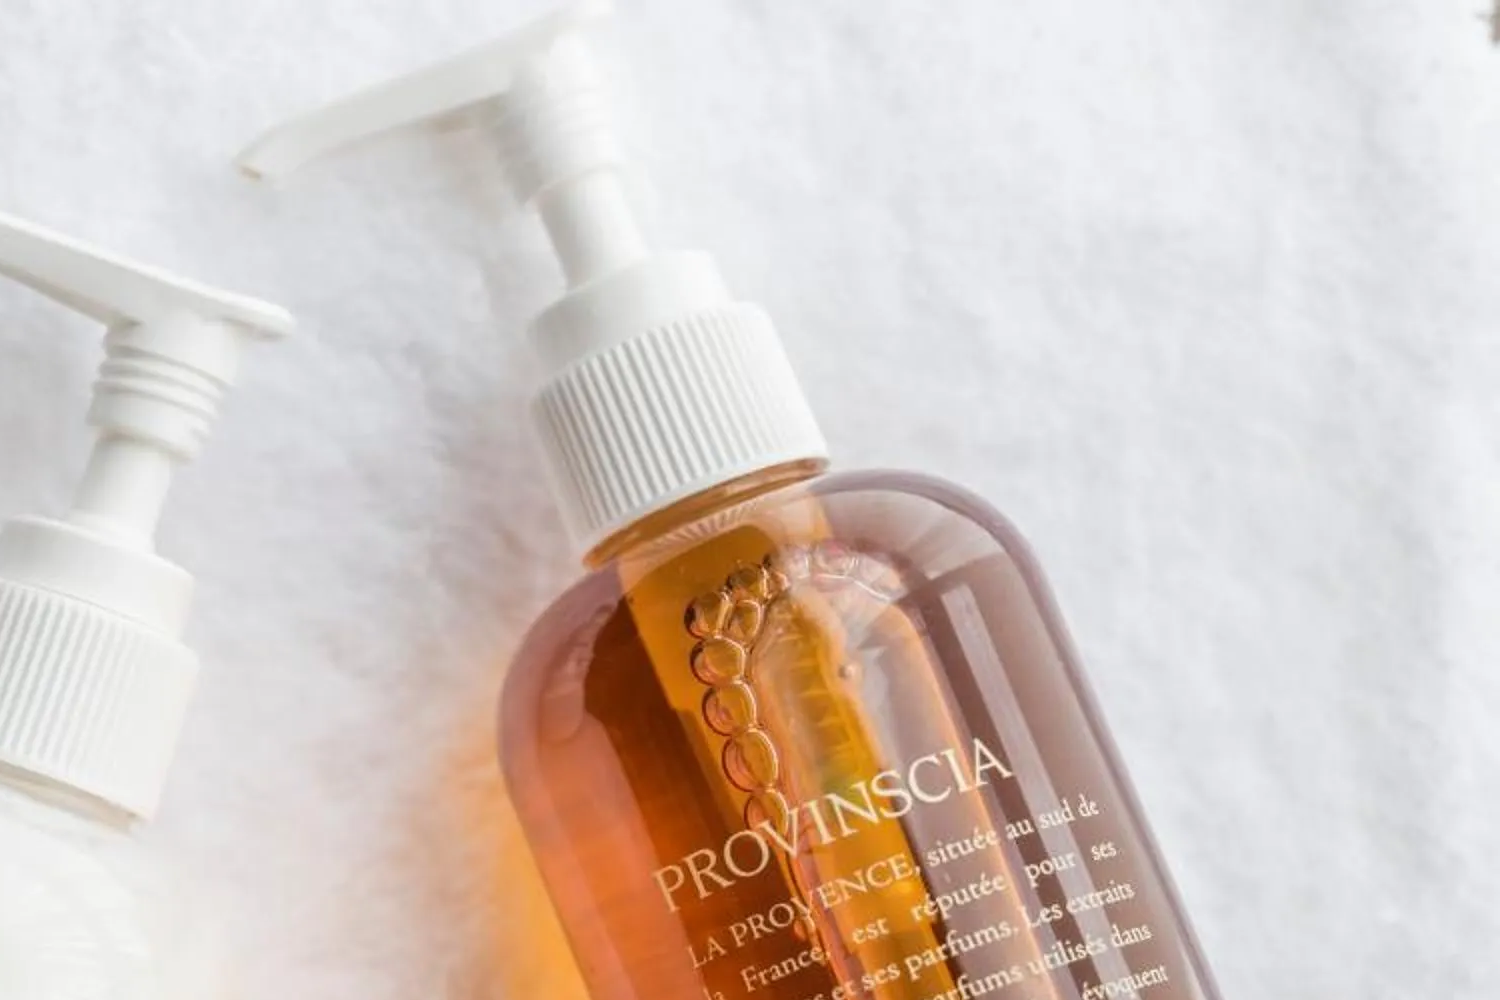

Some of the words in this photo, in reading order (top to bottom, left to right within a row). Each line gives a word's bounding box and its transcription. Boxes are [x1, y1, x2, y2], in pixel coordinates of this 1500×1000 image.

[650, 737, 1016, 913] PROVINSCIA
[686, 933, 728, 968] LA
[726, 854, 923, 949] PROVENCE,
[925, 827, 999, 866] située
[1005, 817, 1035, 839] au
[1038, 797, 1077, 828] sud
[1076, 794, 1099, 818] de
[738, 945, 834, 993] France,
[851, 915, 892, 945] est
[908, 873, 1007, 923] réputée
[1023, 850, 1075, 889] pour
[1089, 840, 1117, 860] ses
[860, 964, 901, 990] ses
[902, 922, 1021, 983] parfums.
[1018, 903, 1063, 930] Les
[1064, 879, 1135, 915] extraits
[1025, 934, 1107, 977] utilisés
[1109, 923, 1152, 948] dans
